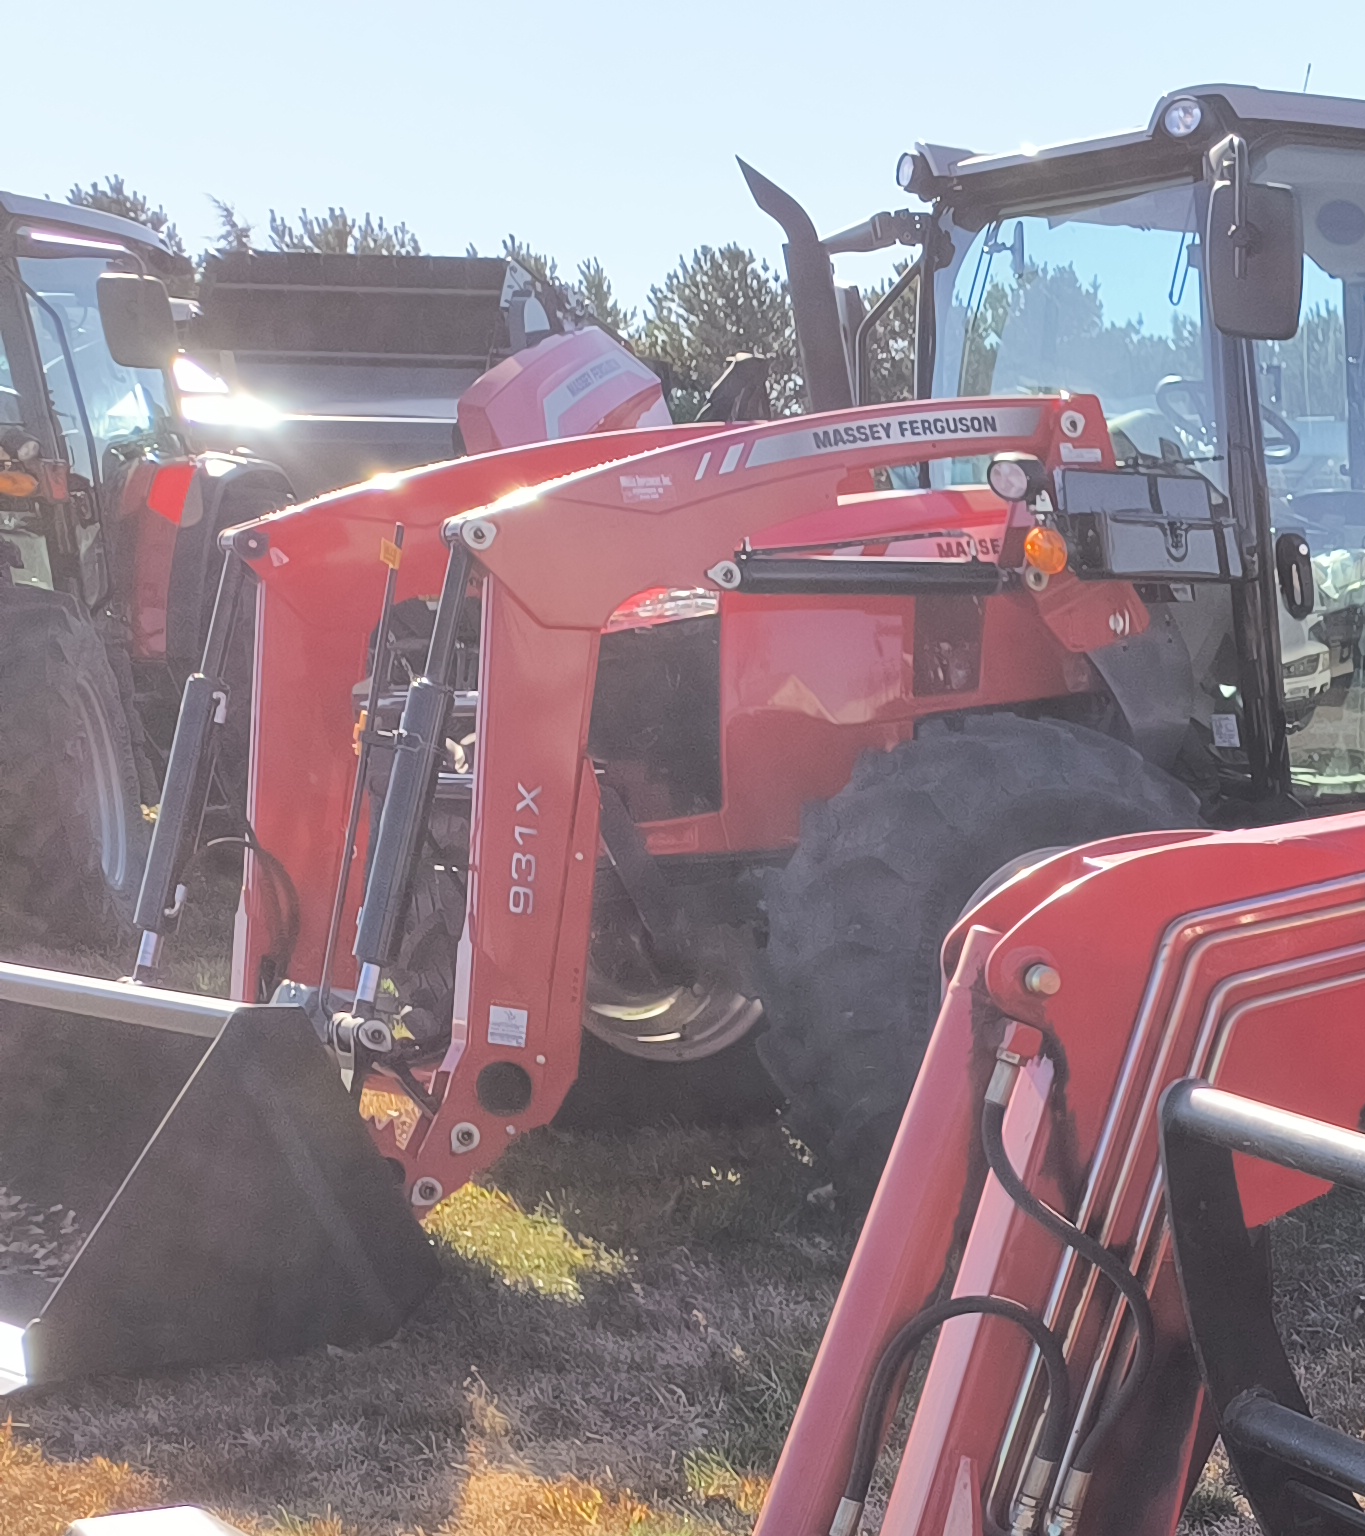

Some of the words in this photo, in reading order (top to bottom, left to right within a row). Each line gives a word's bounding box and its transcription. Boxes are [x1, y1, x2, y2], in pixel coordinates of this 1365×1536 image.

[812, 422, 892, 450] MASSEY
[898, 415, 998, 438] FERGUSON
[508, 781, 543, 916] 931X
